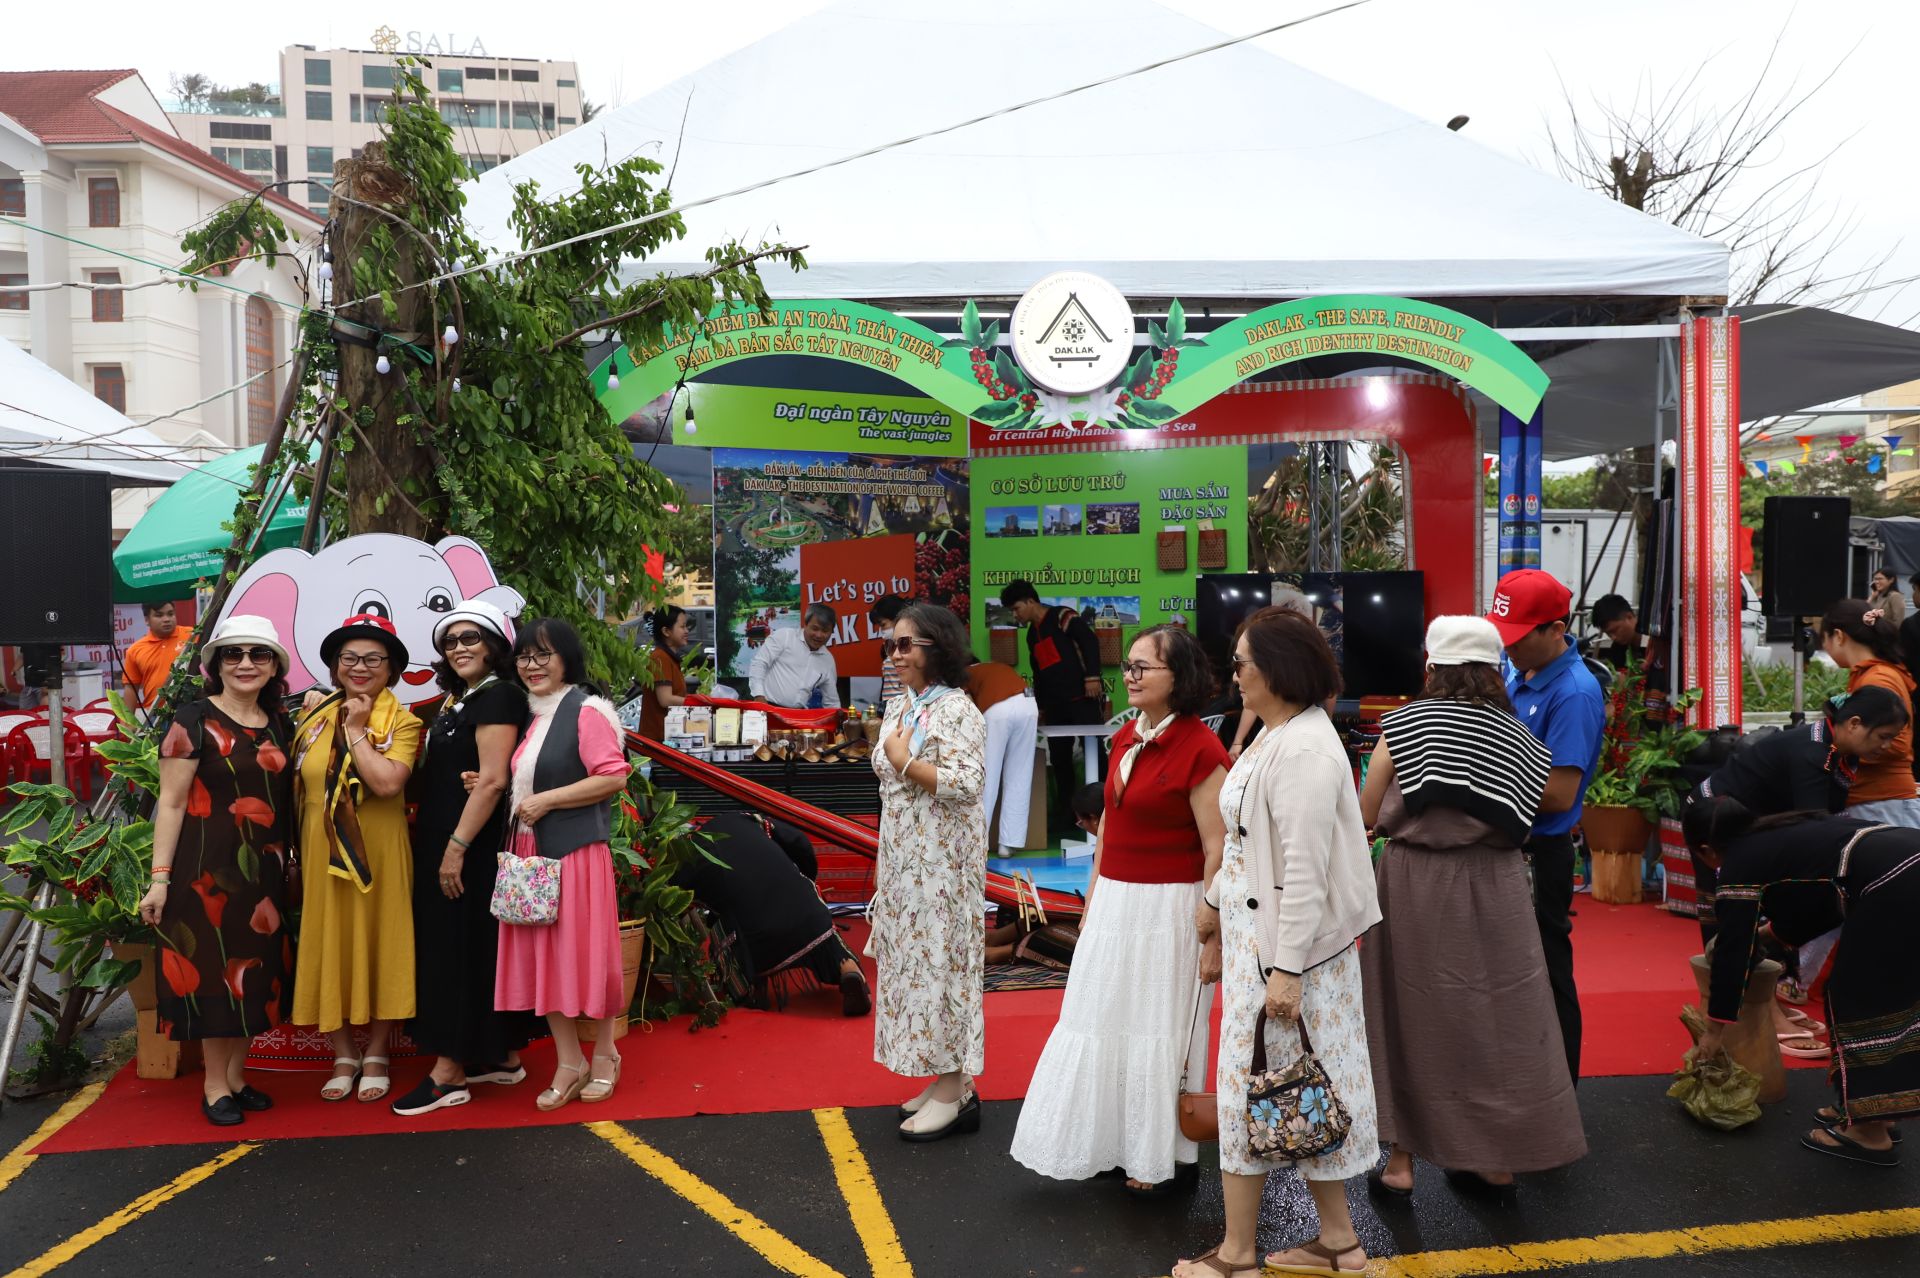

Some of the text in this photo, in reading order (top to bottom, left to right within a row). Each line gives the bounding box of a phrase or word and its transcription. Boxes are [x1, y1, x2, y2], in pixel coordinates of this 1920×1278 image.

[406, 31, 488, 56] SALA
[1244, 314, 1306, 345] DAKLAK
[1315, 309, 1347, 327] THE
[1350, 308, 1391, 328] SAFE,
[1394, 310, 1466, 343] FRIENDLY
[738, 331, 770, 355] BẢN
[774, 327, 804, 352] SẮC
[807, 333, 839, 355] TÂY
[840, 340, 902, 372] NGUYÊN
[783, 310, 804, 327] AN
[807, 308, 851, 335] TOÀN,
[856, 318, 898, 345] THÂN
[898, 331, 945, 370] THIỆN,
[1054, 346, 1094, 354] DAK LAK
[1236, 333, 1474, 377] AND RICH IDENTITY DESTINATION
[775, 403, 951, 427] Đại ngàn Tây Nguyên
[859, 427, 951, 443] The vast jungles
[989, 431, 1000, 441] of
[1004, 429, 1048, 440] Central
[1173, 422, 1197, 431] Sea
[787, 480, 804, 492] THE
[804, 480, 859, 494] DESTINATION
[860, 482, 872, 494] OF
[872, 483, 887, 495] THE
[887, 484, 917, 496] WORLD
[918, 485, 945, 497] COFFEE
[991, 472, 1126, 494] CƠ SỞ LƯU TRÚ
[1160, 480, 1229, 500] MUA SẮM
[1161, 501, 1227, 522] ĐẶC SẢN
[1023, 562, 1066, 584] ĐIỂM
[1070, 568, 1095, 584] DU
[1098, 568, 1141, 587] LỊCH
[862, 580, 886, 603] go
[891, 575, 910, 594] to
[1160, 596, 1182, 612] LỮ
[825, 613, 860, 647] AK
